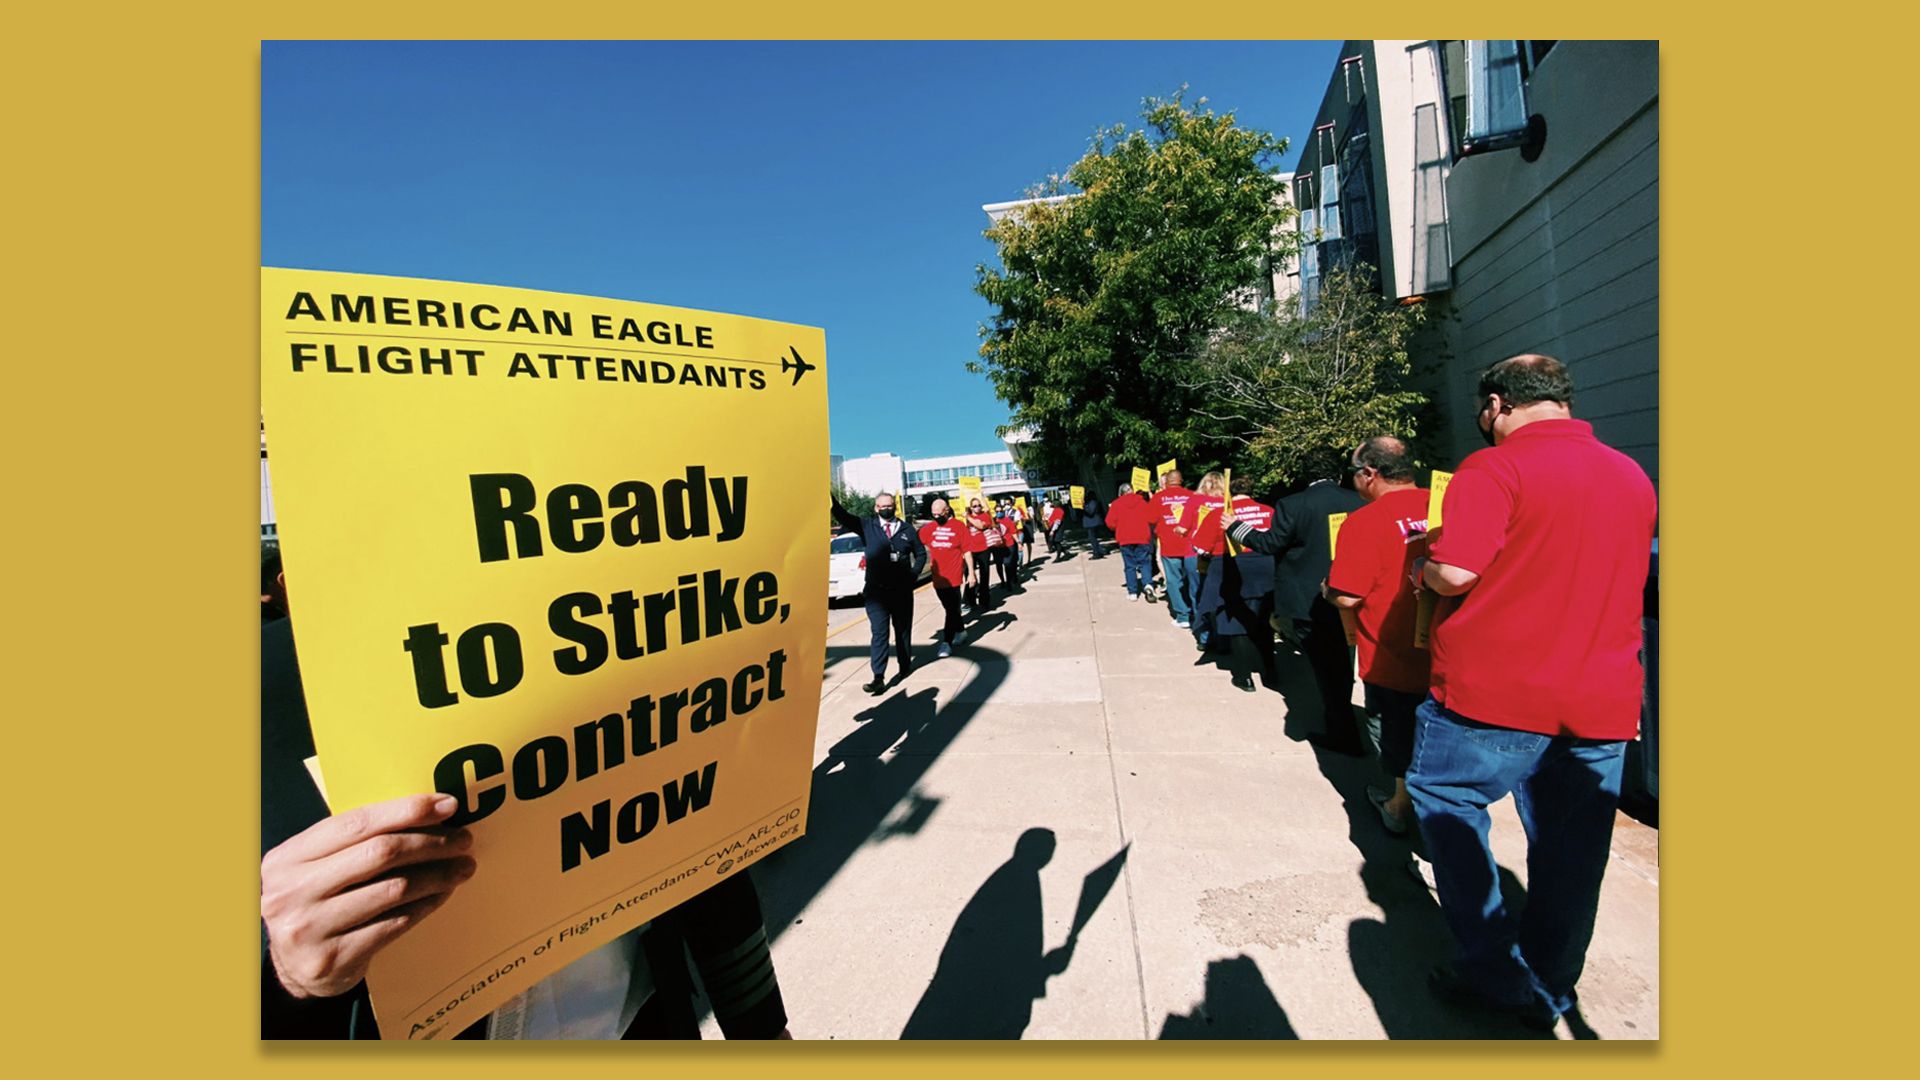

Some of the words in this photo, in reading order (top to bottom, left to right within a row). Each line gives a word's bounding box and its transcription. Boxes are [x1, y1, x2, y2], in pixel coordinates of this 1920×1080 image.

[285, 291, 573, 336] AMERICAN
[591, 314, 714, 349] EAGLE
[290, 343, 485, 376] FLIGHT
[507, 352, 767, 390] ATTENDANTS
[469, 465, 748, 563] Ready
[1395, 517, 1429, 537] Live
[403, 622, 524, 709] to
[548, 569, 791, 676] Strike,
[433, 648, 787, 828] Contract
[408, 955, 526, 1040] Association
[533, 936, 554, 956] of
[559, 912, 608, 942] Flight
[746, 808, 800, 844] AFL-CIO
